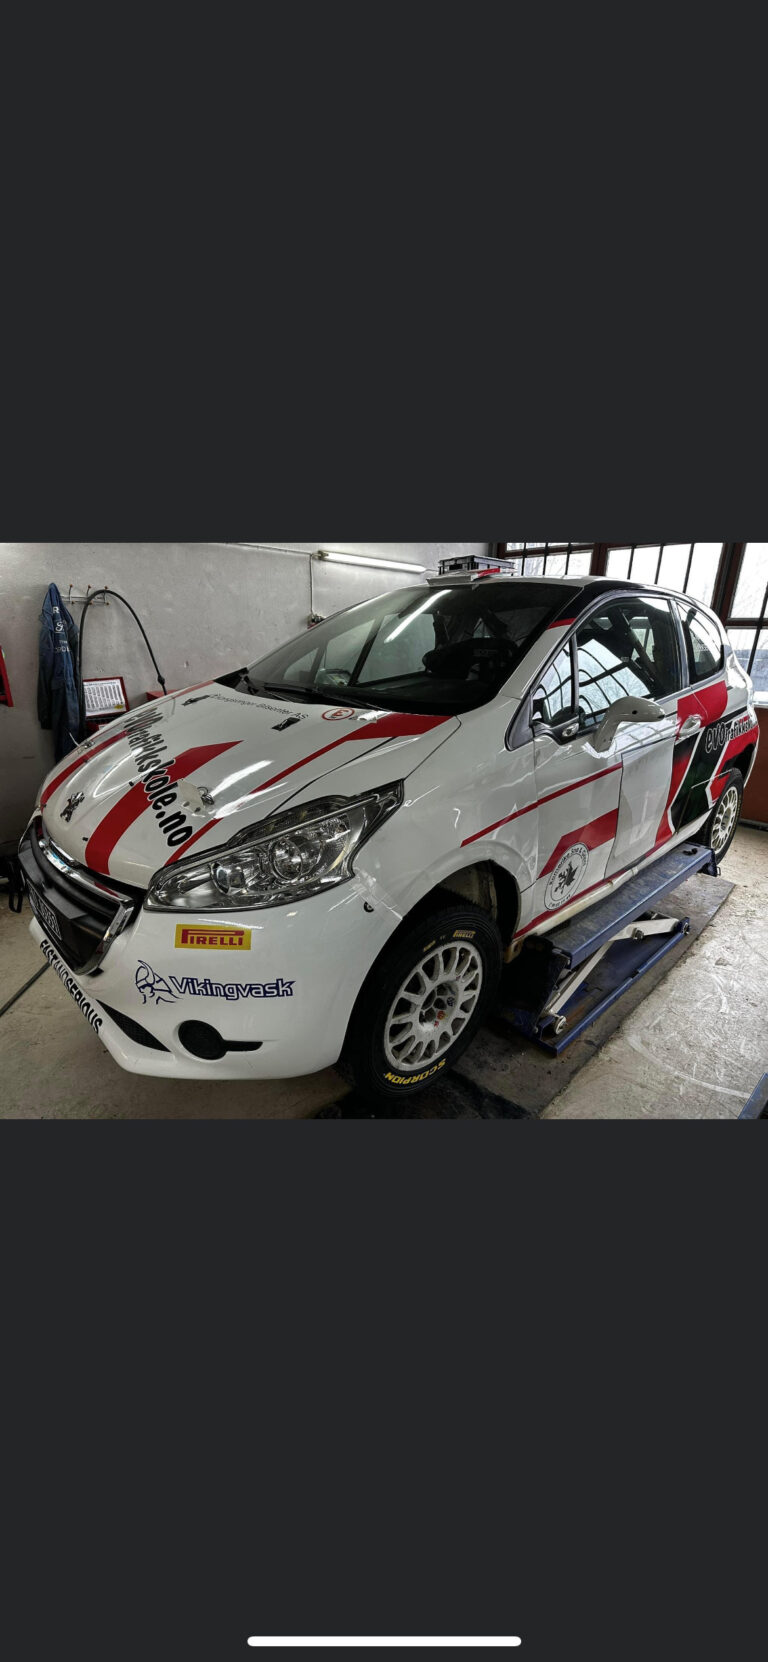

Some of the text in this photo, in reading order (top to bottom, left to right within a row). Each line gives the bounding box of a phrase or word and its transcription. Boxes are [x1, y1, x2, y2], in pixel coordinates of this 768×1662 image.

[181, 928, 245, 946] PIRELLI
[168, 975, 297, 1001] Vikingvask
[384, 1058, 447, 1085] SCORPION
